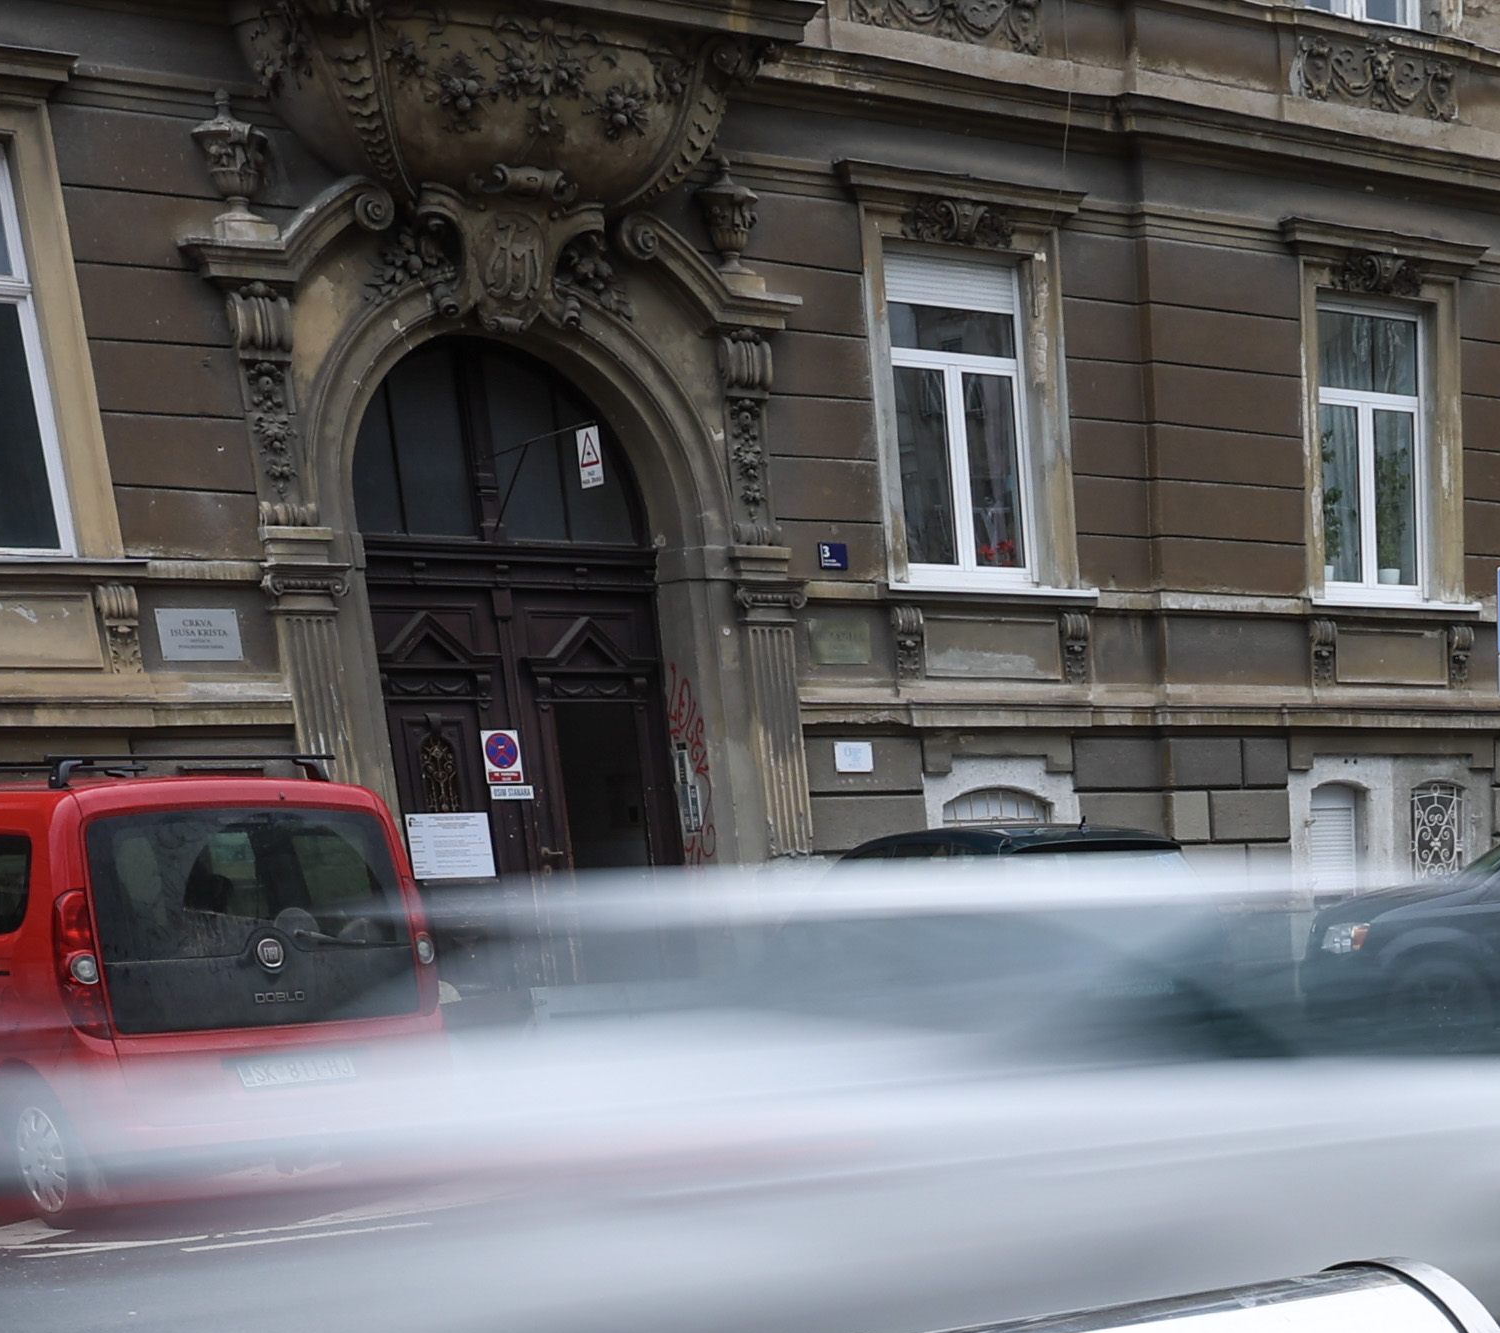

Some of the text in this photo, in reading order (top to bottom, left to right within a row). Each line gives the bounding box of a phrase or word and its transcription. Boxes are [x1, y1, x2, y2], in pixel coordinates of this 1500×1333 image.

[821, 544, 831, 558] 3
[182, 619, 213, 628] CRKVA
[170, 628, 228, 638] ISUSA KRISTA
[263, 946, 279, 961] FIAT
[254, 990, 306, 1003] DOBLO
